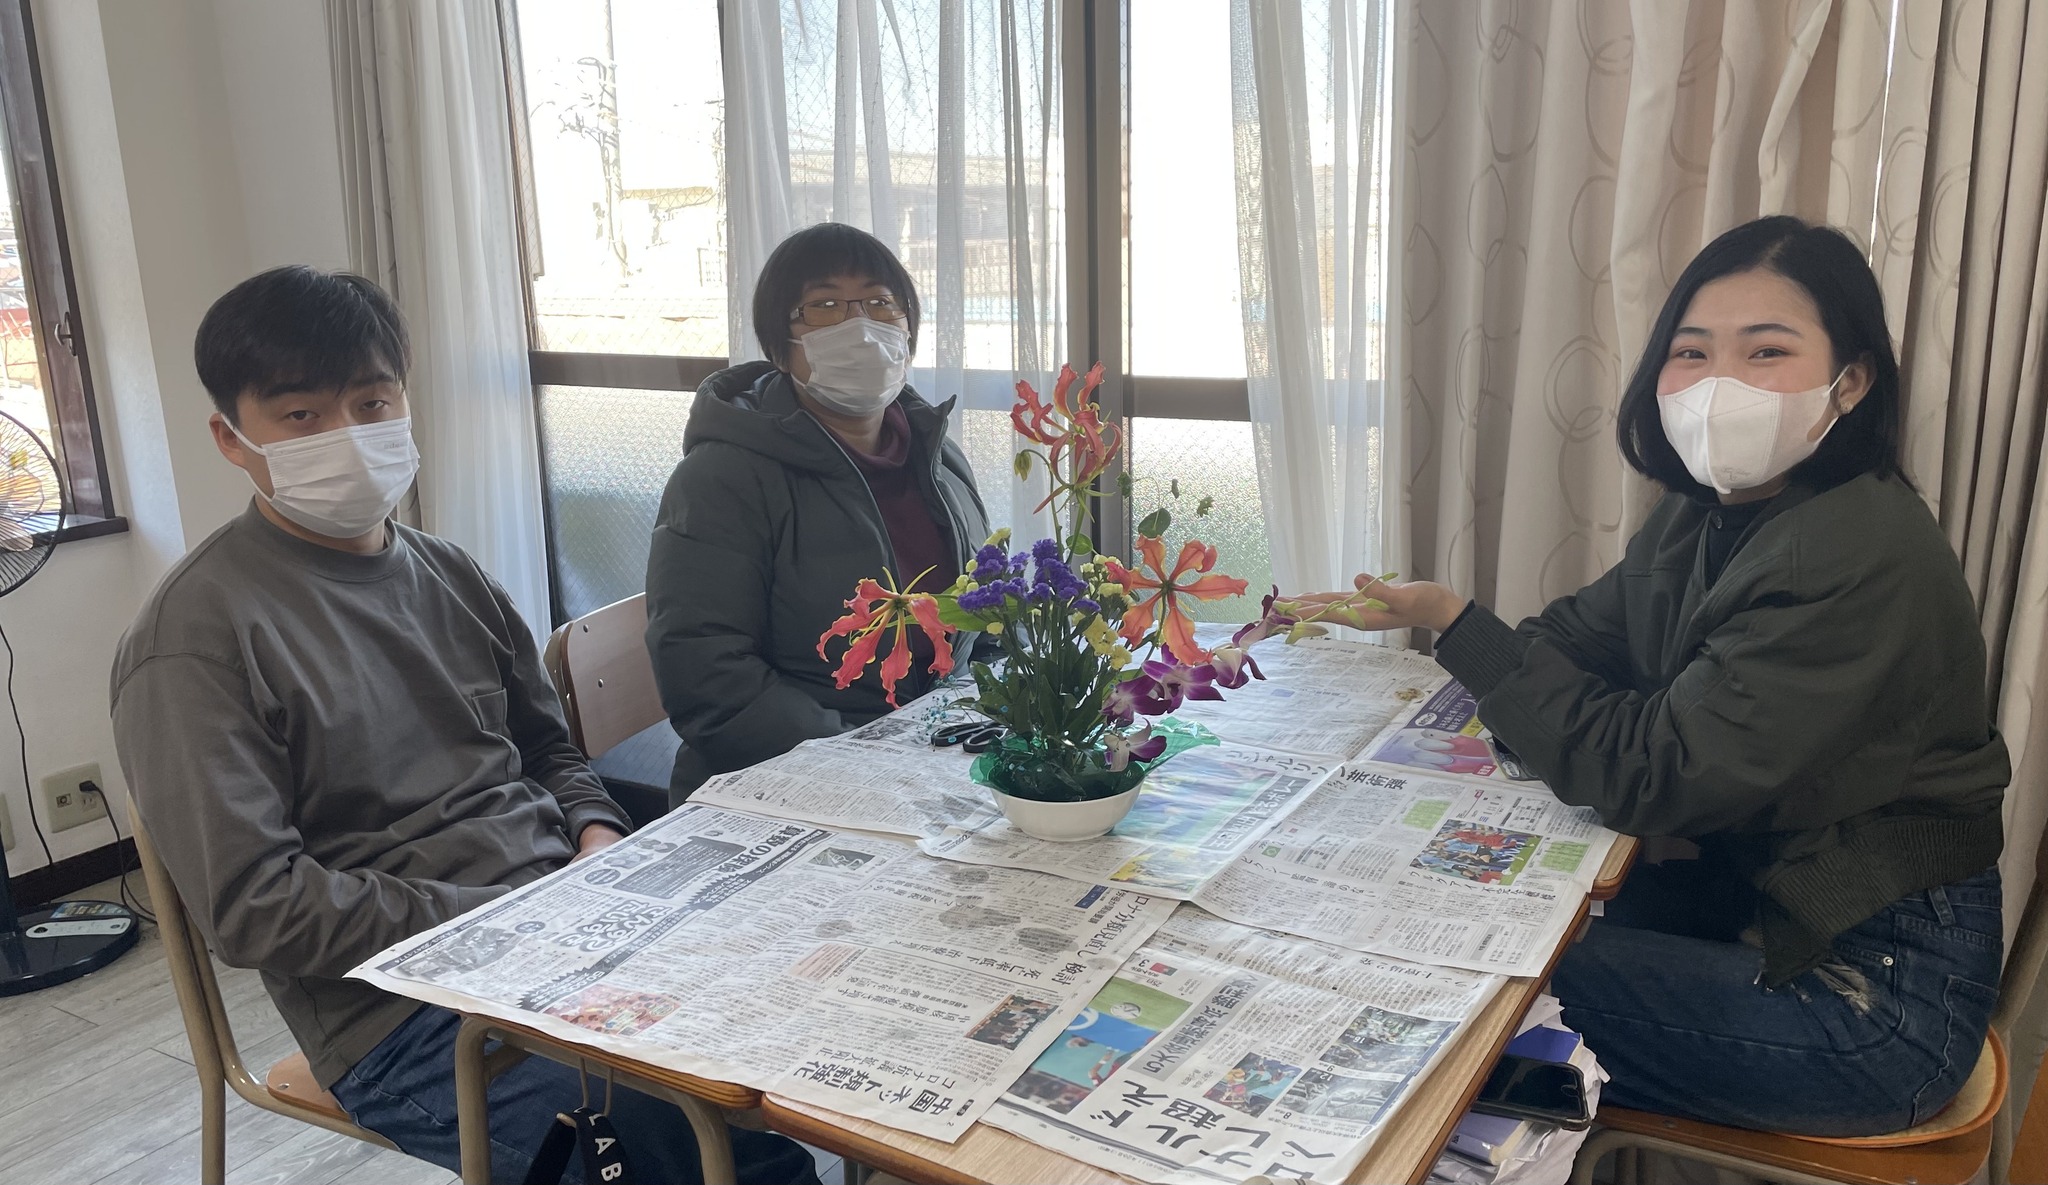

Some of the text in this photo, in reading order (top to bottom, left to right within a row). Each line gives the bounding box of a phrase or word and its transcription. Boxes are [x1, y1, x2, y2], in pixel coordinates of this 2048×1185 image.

[1344, 769, 1408, 790] 芸術弾
[710, 824, 808, 874] 算数の探険
[1048, 961, 1088, 986] 検討
[1136, 958, 1151, 967] 3
[1135, 1005, 1230, 1073] 5大会連続得点
[790, 1056, 959, 1117] 中国 ネット規制強化
[1117, 1079, 1339, 1160] ペレ超え
